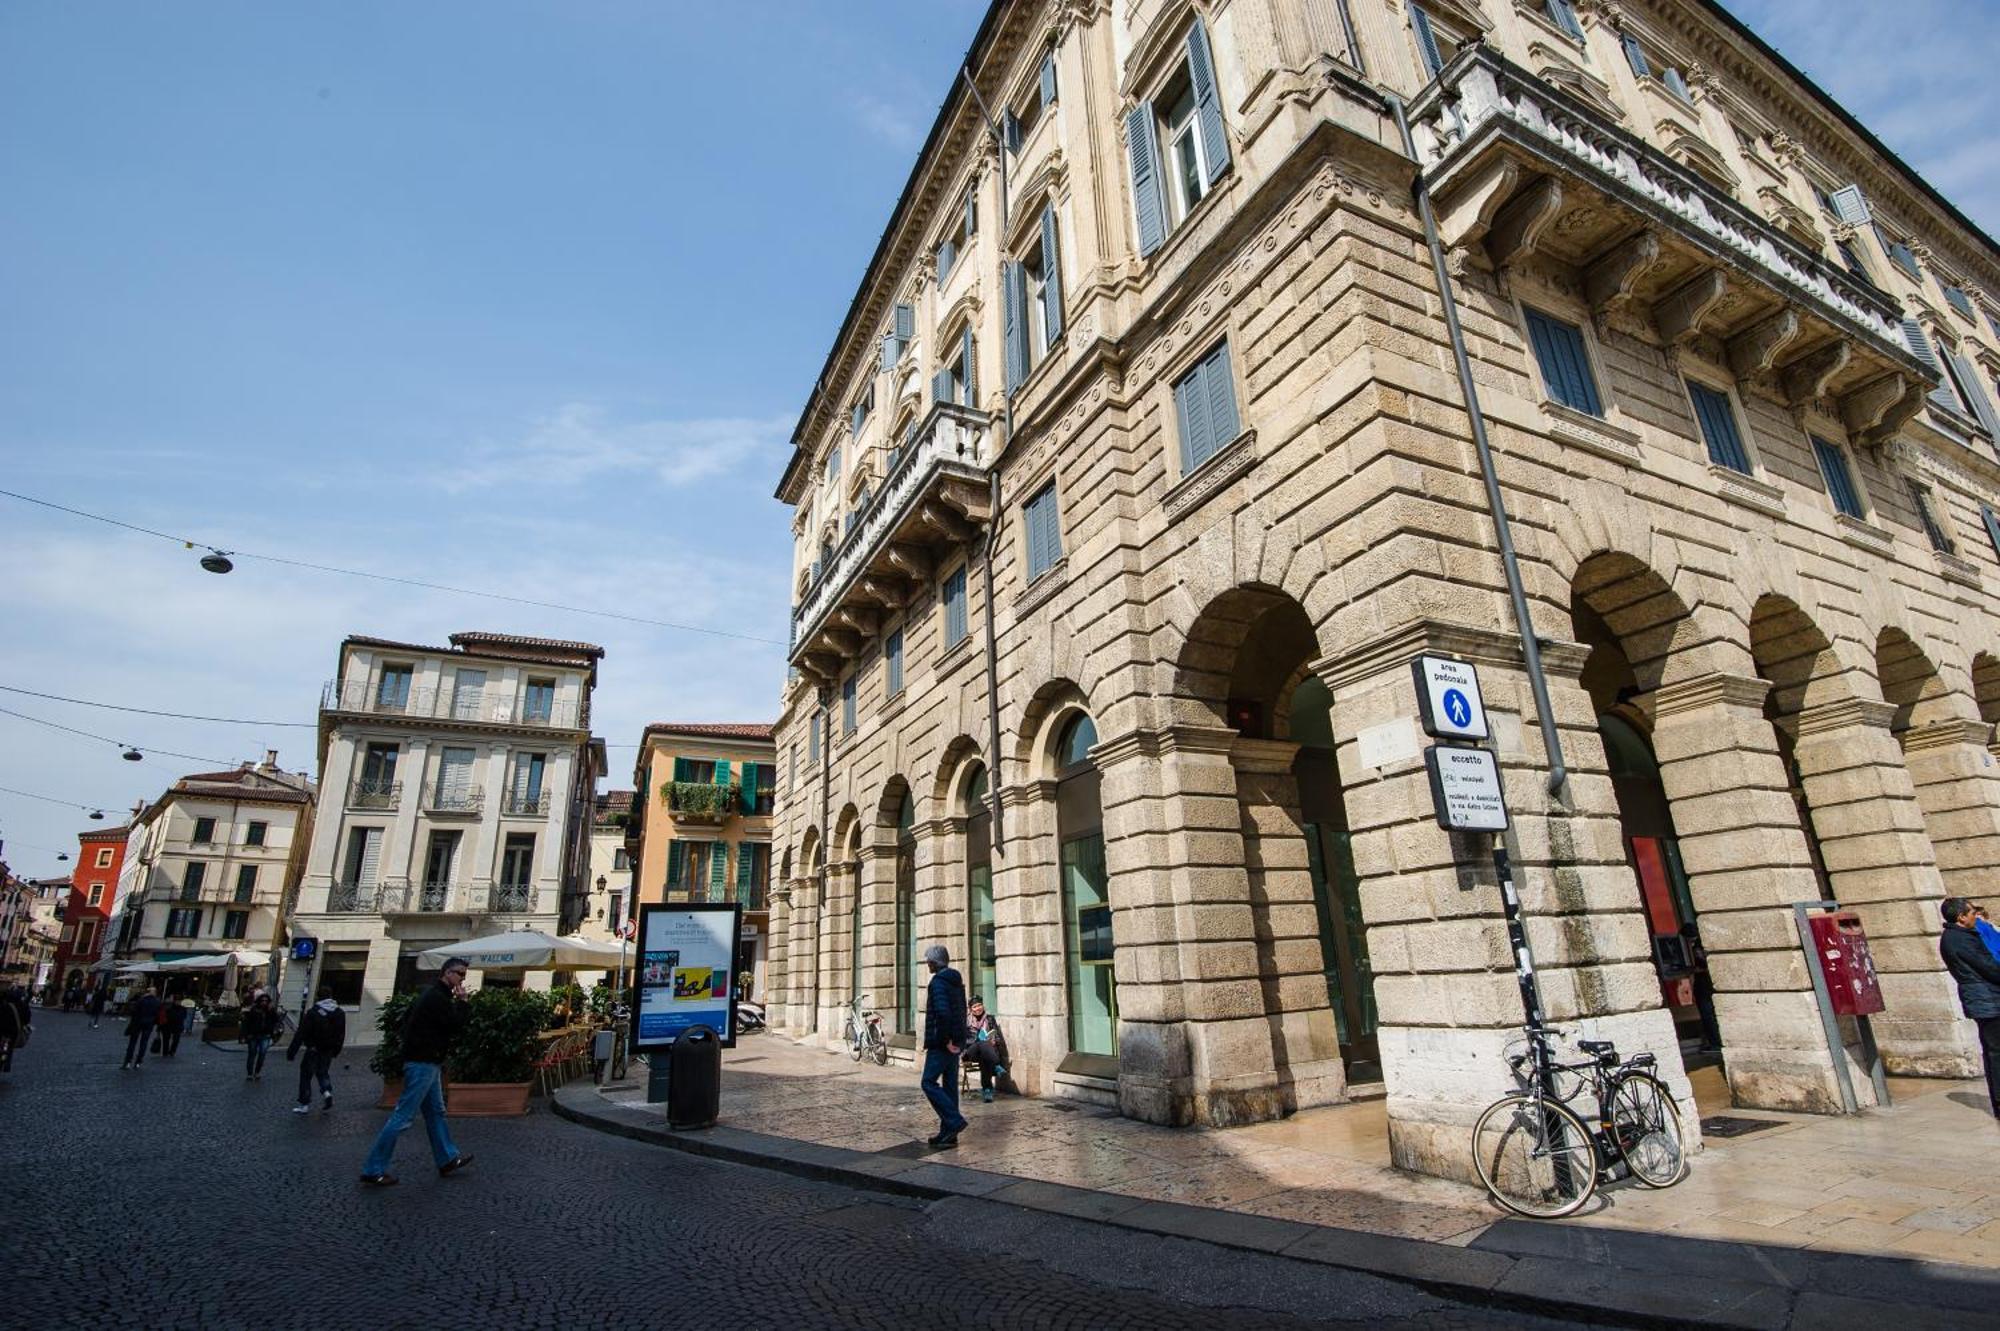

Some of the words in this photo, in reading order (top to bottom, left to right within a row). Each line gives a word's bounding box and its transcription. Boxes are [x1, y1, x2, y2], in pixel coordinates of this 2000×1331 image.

[1441, 664, 1456, 672] area
[1434, 673, 1467, 684] pedonale
[1451, 756, 1482, 765] eccetto
